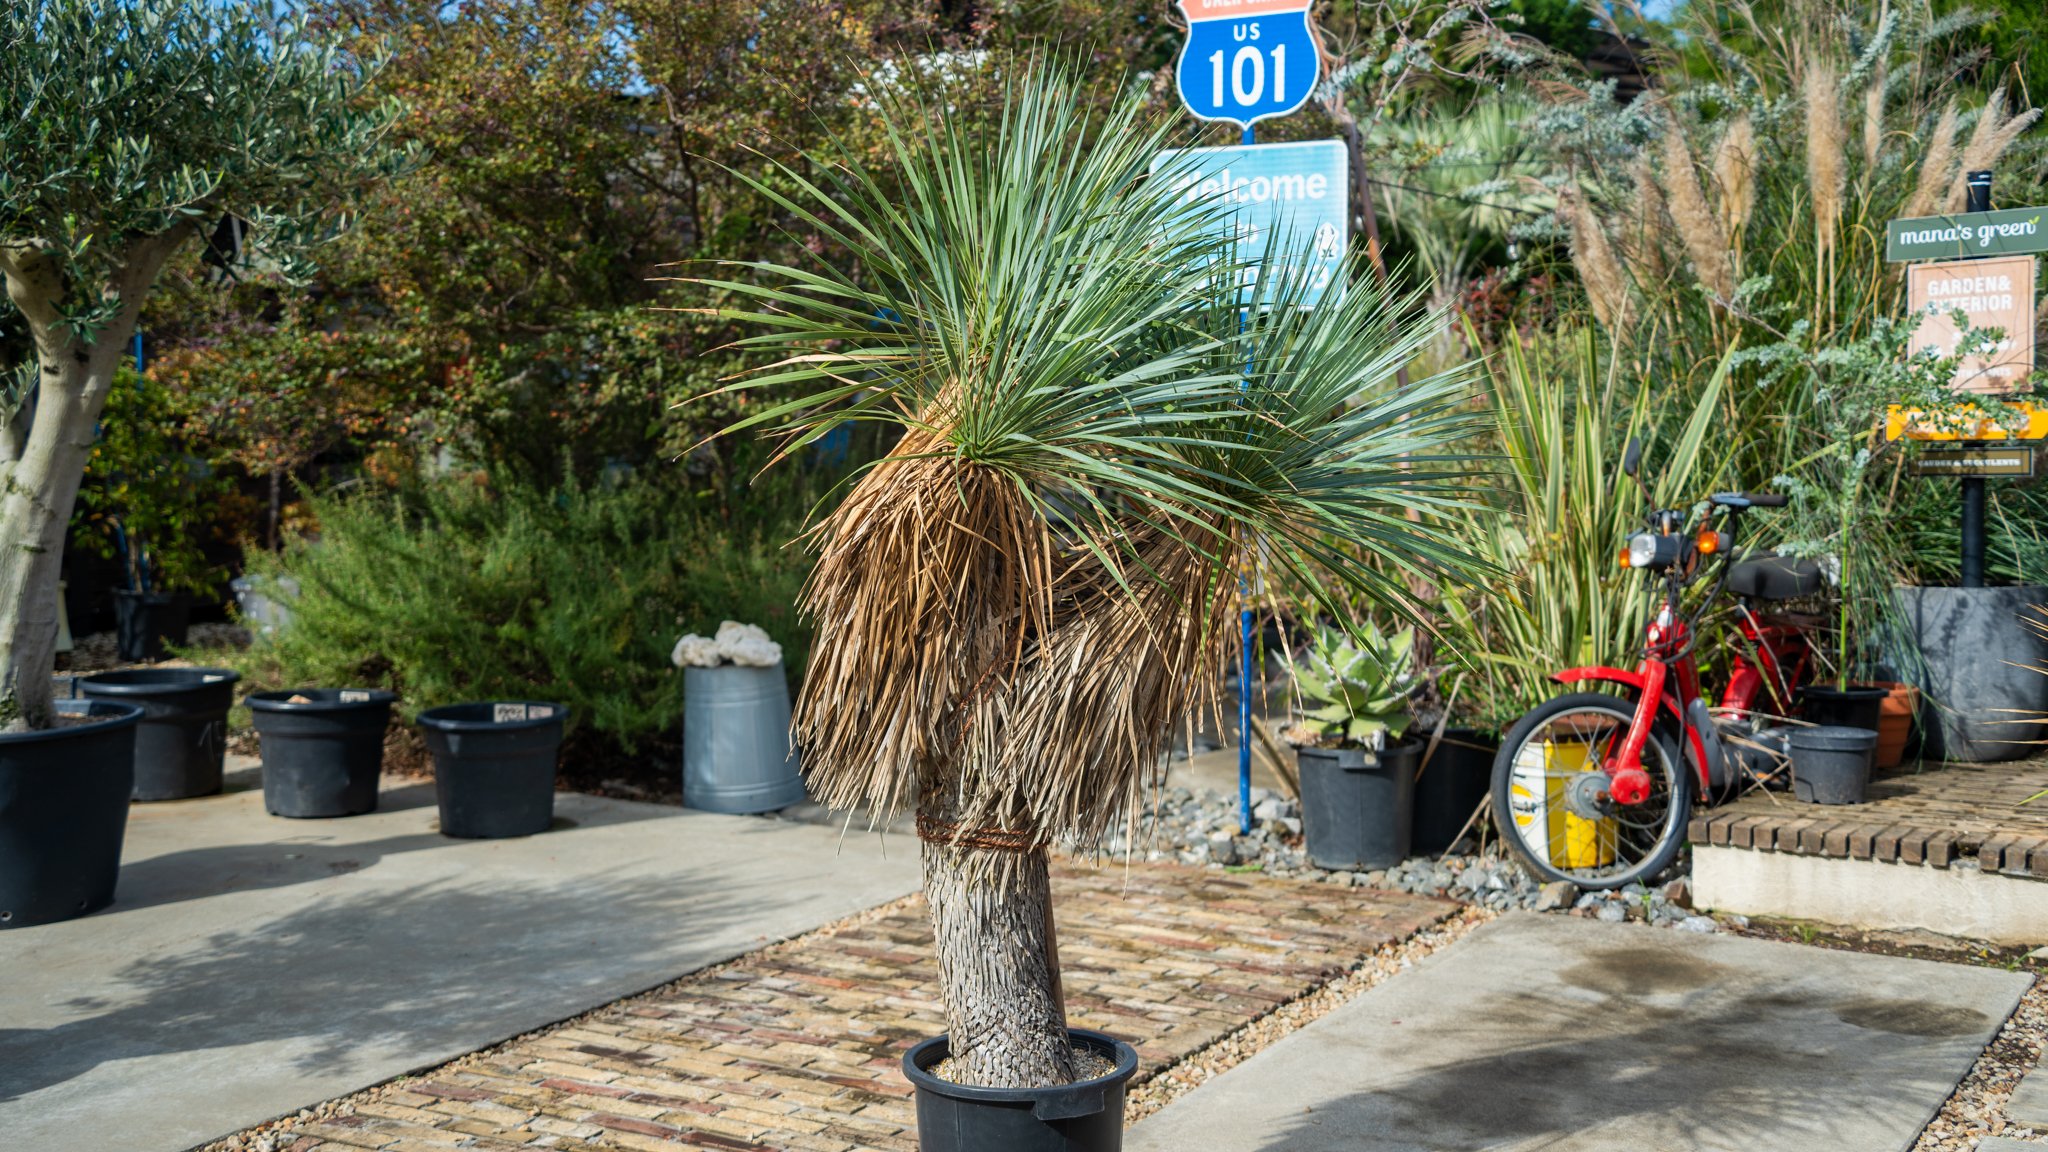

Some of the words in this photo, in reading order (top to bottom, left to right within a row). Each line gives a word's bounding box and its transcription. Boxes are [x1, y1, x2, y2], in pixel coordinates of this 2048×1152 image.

[1233, 22, 1261, 42] US
[1209, 43, 1286, 108] 101
[1168, 166, 1328, 206] Welcome
[1900, 224, 1973, 245] mana's
[1978, 221, 2037, 247] green
[1927, 274, 2012, 297] GARDEN&
